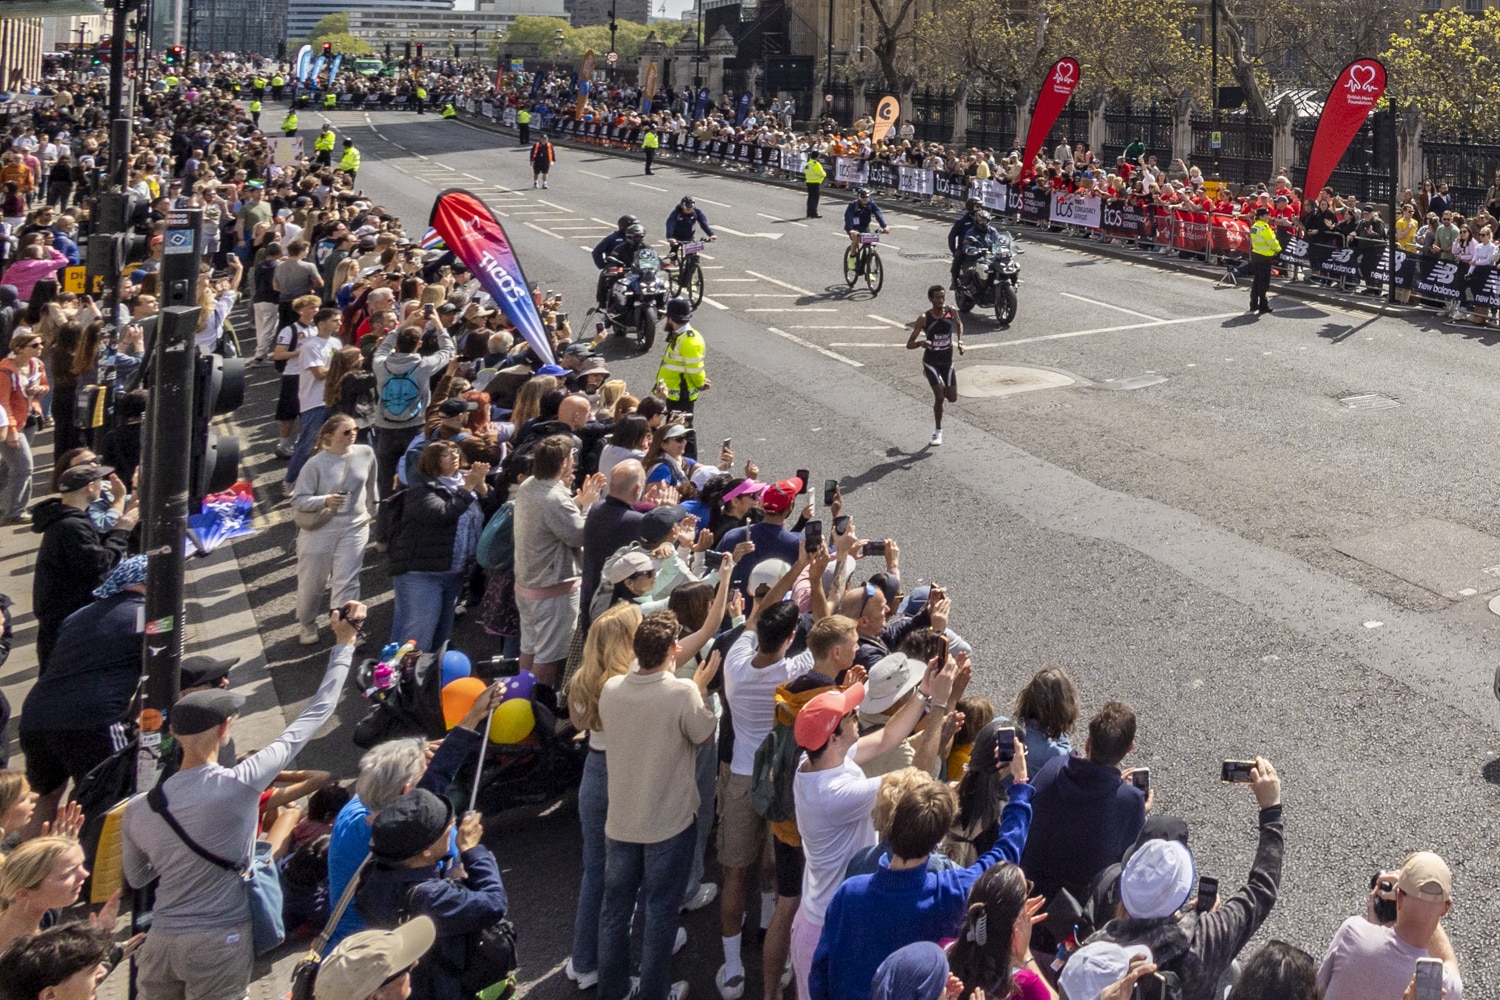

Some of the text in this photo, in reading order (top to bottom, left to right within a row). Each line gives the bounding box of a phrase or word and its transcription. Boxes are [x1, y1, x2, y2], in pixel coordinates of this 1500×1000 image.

[936, 173, 950, 193] tcs
[1009, 188, 1024, 209] tcs
[1055, 195, 1073, 218] tcs
[1103, 205, 1122, 227] tcs
[1417, 281, 1461, 298] new balance
[1475, 294, 1489, 304] new
